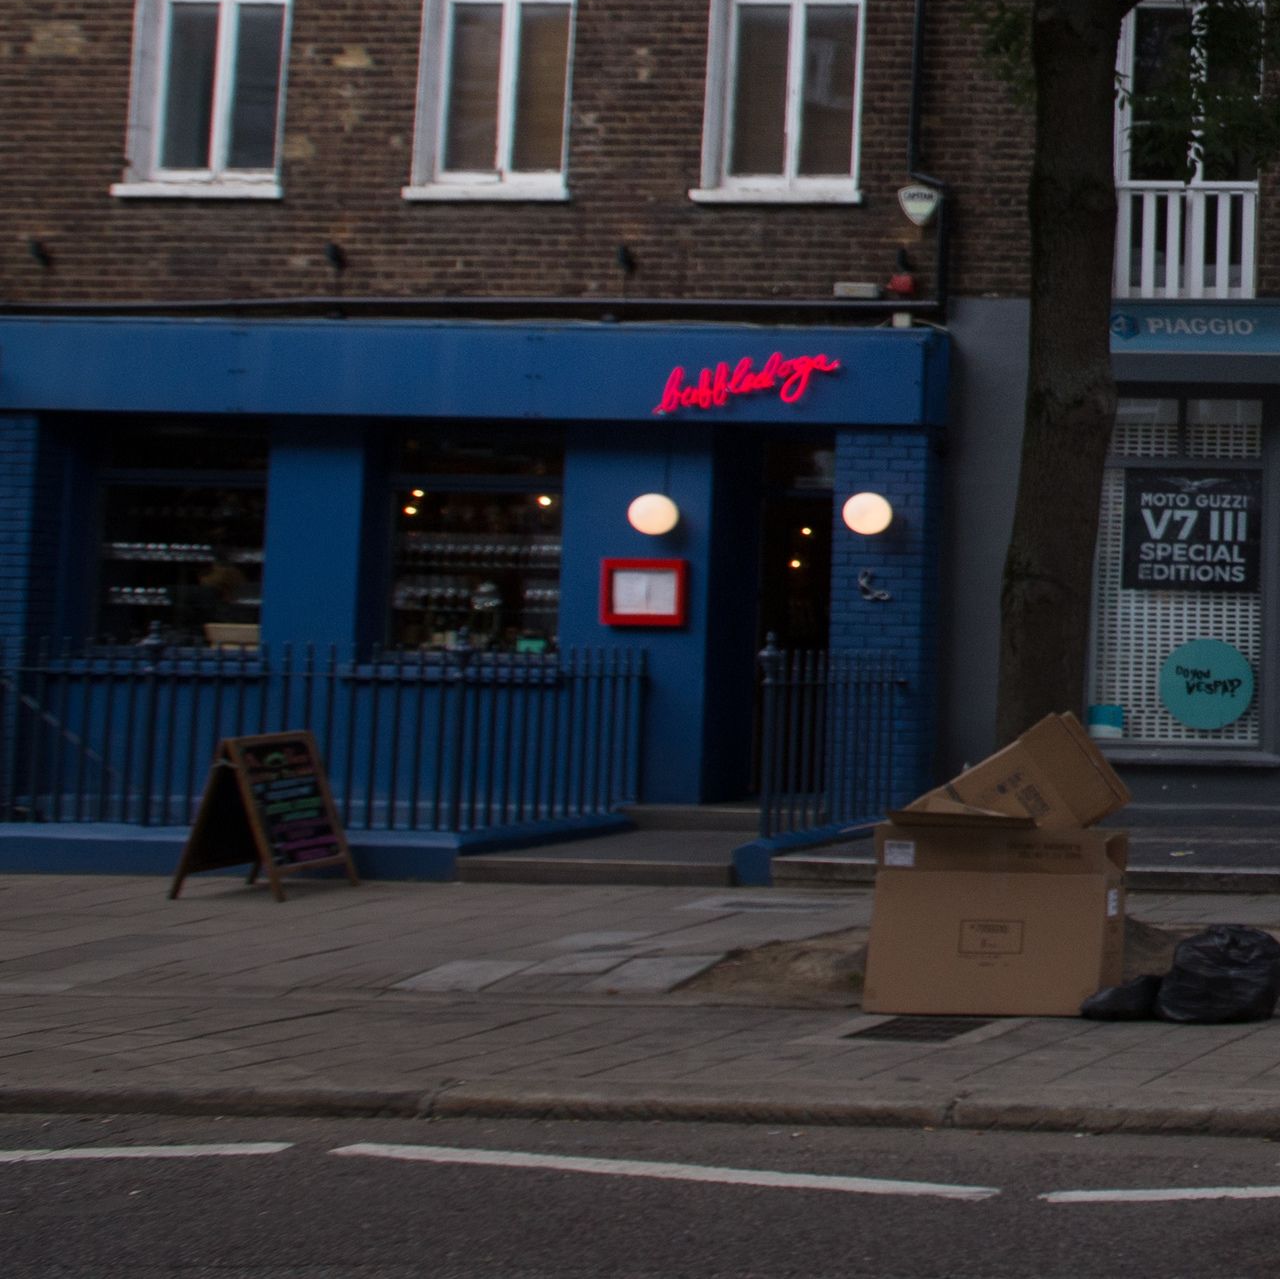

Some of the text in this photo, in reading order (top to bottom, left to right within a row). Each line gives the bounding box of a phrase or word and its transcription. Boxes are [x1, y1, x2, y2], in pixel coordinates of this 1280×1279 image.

[1147, 318, 1250, 336] PIAGGIO
[1140, 493, 1248, 508] MOTO GUZZI
[1140, 508, 1247, 542] V7 III
[1139, 542, 1246, 563] SPECIAL
[1137, 563, 1246, 582] EDITIONS
